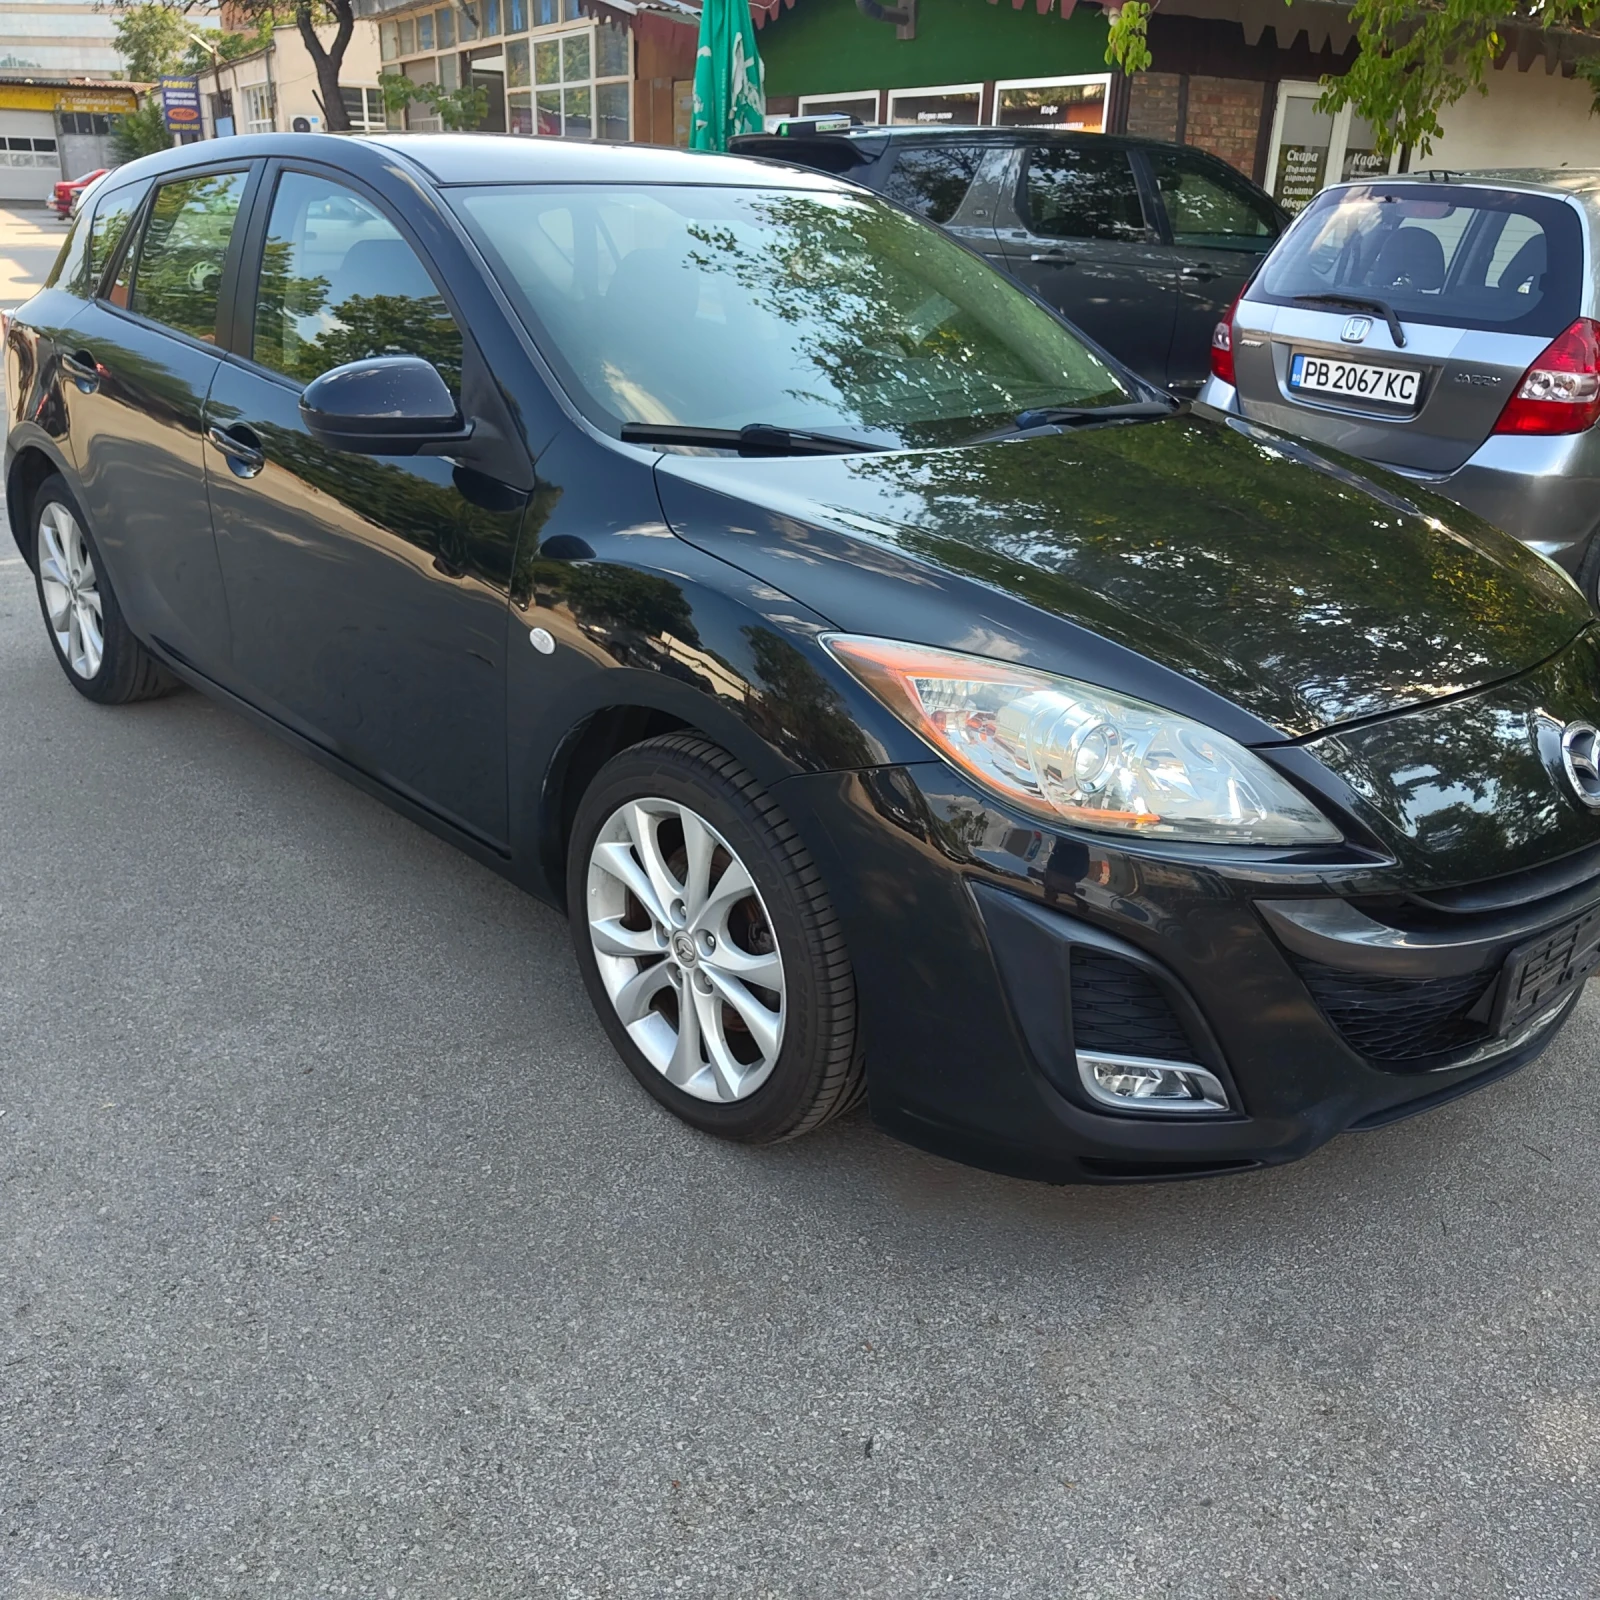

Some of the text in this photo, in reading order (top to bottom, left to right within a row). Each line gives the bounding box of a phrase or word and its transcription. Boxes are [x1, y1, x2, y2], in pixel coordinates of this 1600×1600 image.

[1286, 149, 1318, 165] Скара
[1353, 153, 1383, 168] Кафе
[1283, 186, 1314, 195] Салати
[1281, 198, 1309, 210] Обедн
[1303, 361, 1415, 400] PB 2067 KC
